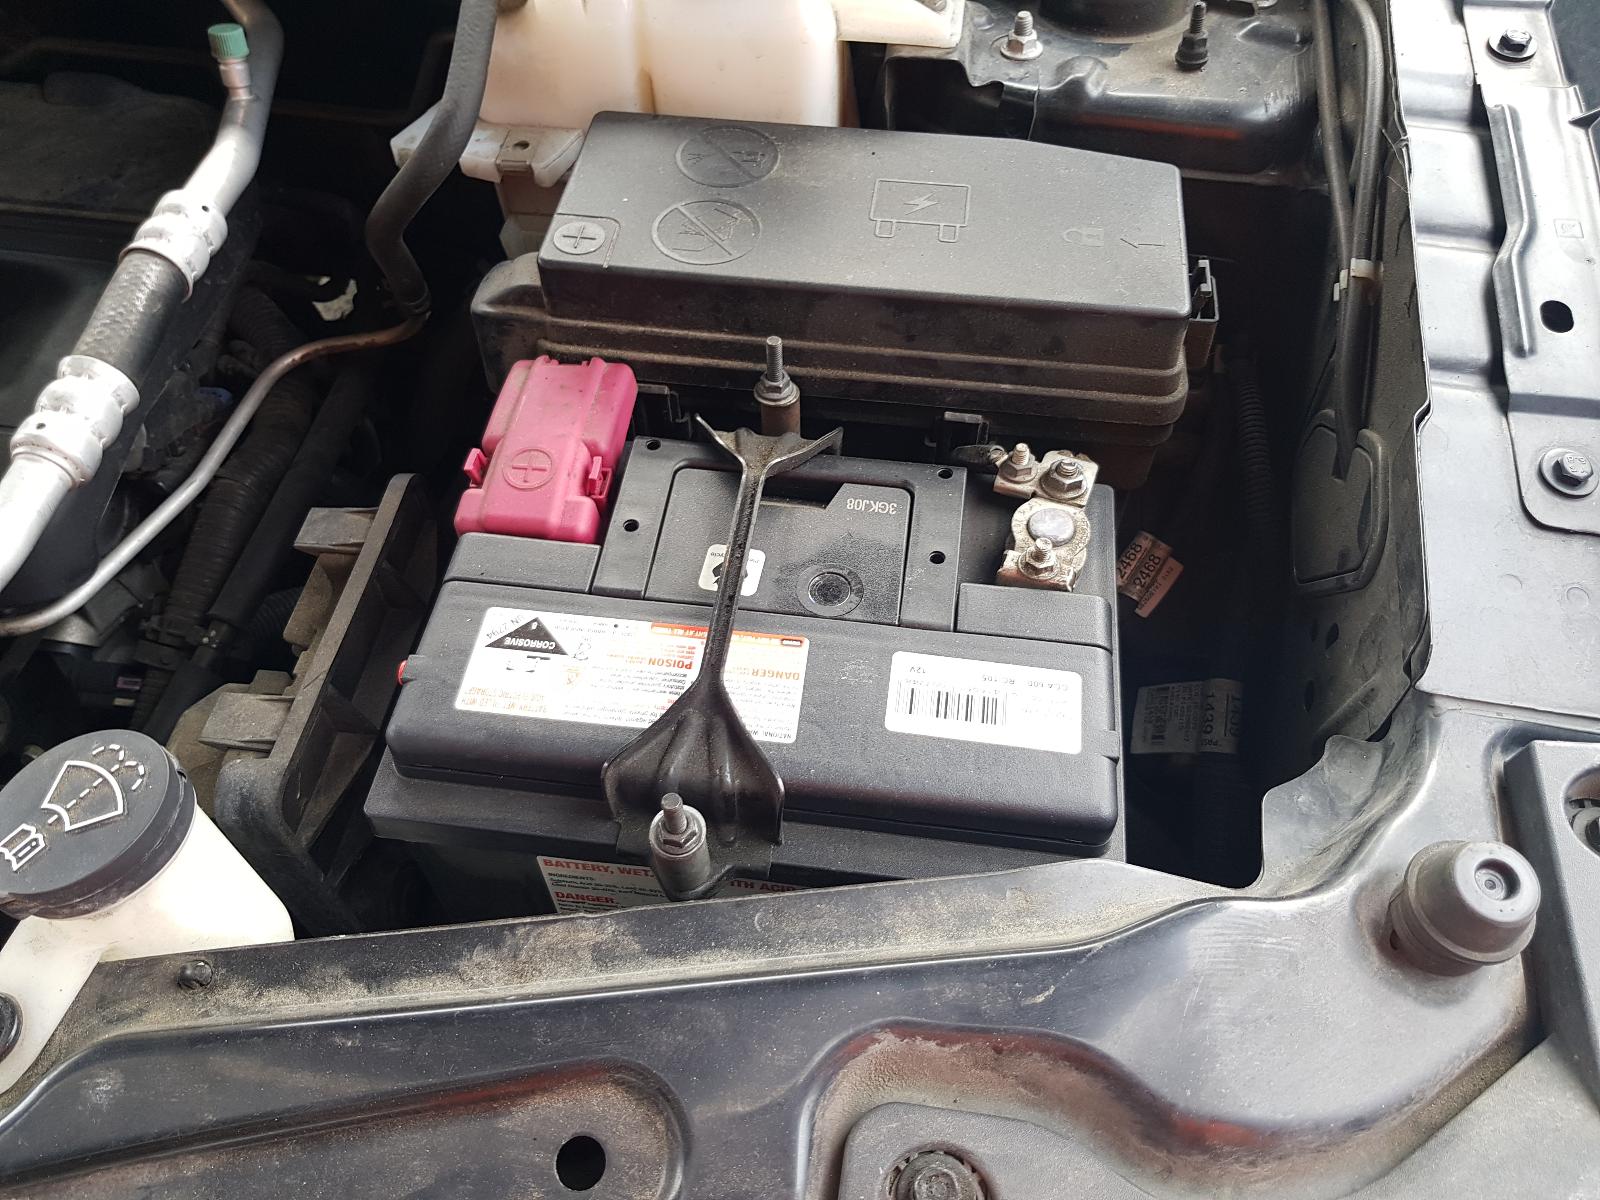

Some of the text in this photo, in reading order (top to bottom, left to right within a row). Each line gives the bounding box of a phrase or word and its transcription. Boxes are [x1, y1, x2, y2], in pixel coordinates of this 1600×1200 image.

[846, 498, 897, 514] 3GKJ08
[1116, 543, 1143, 579] 2468
[1133, 554, 1161, 588] 2468
[504, 637, 556, 650] CORROSIVE
[648, 657, 693, 670] POISON
[909, 666, 926, 674] 12V
[752, 668, 800, 681] DANGER
[1202, 693, 1215, 735] 1439
[543, 859, 615, 874] BATTERY,
[730, 880, 755, 889] ITH
